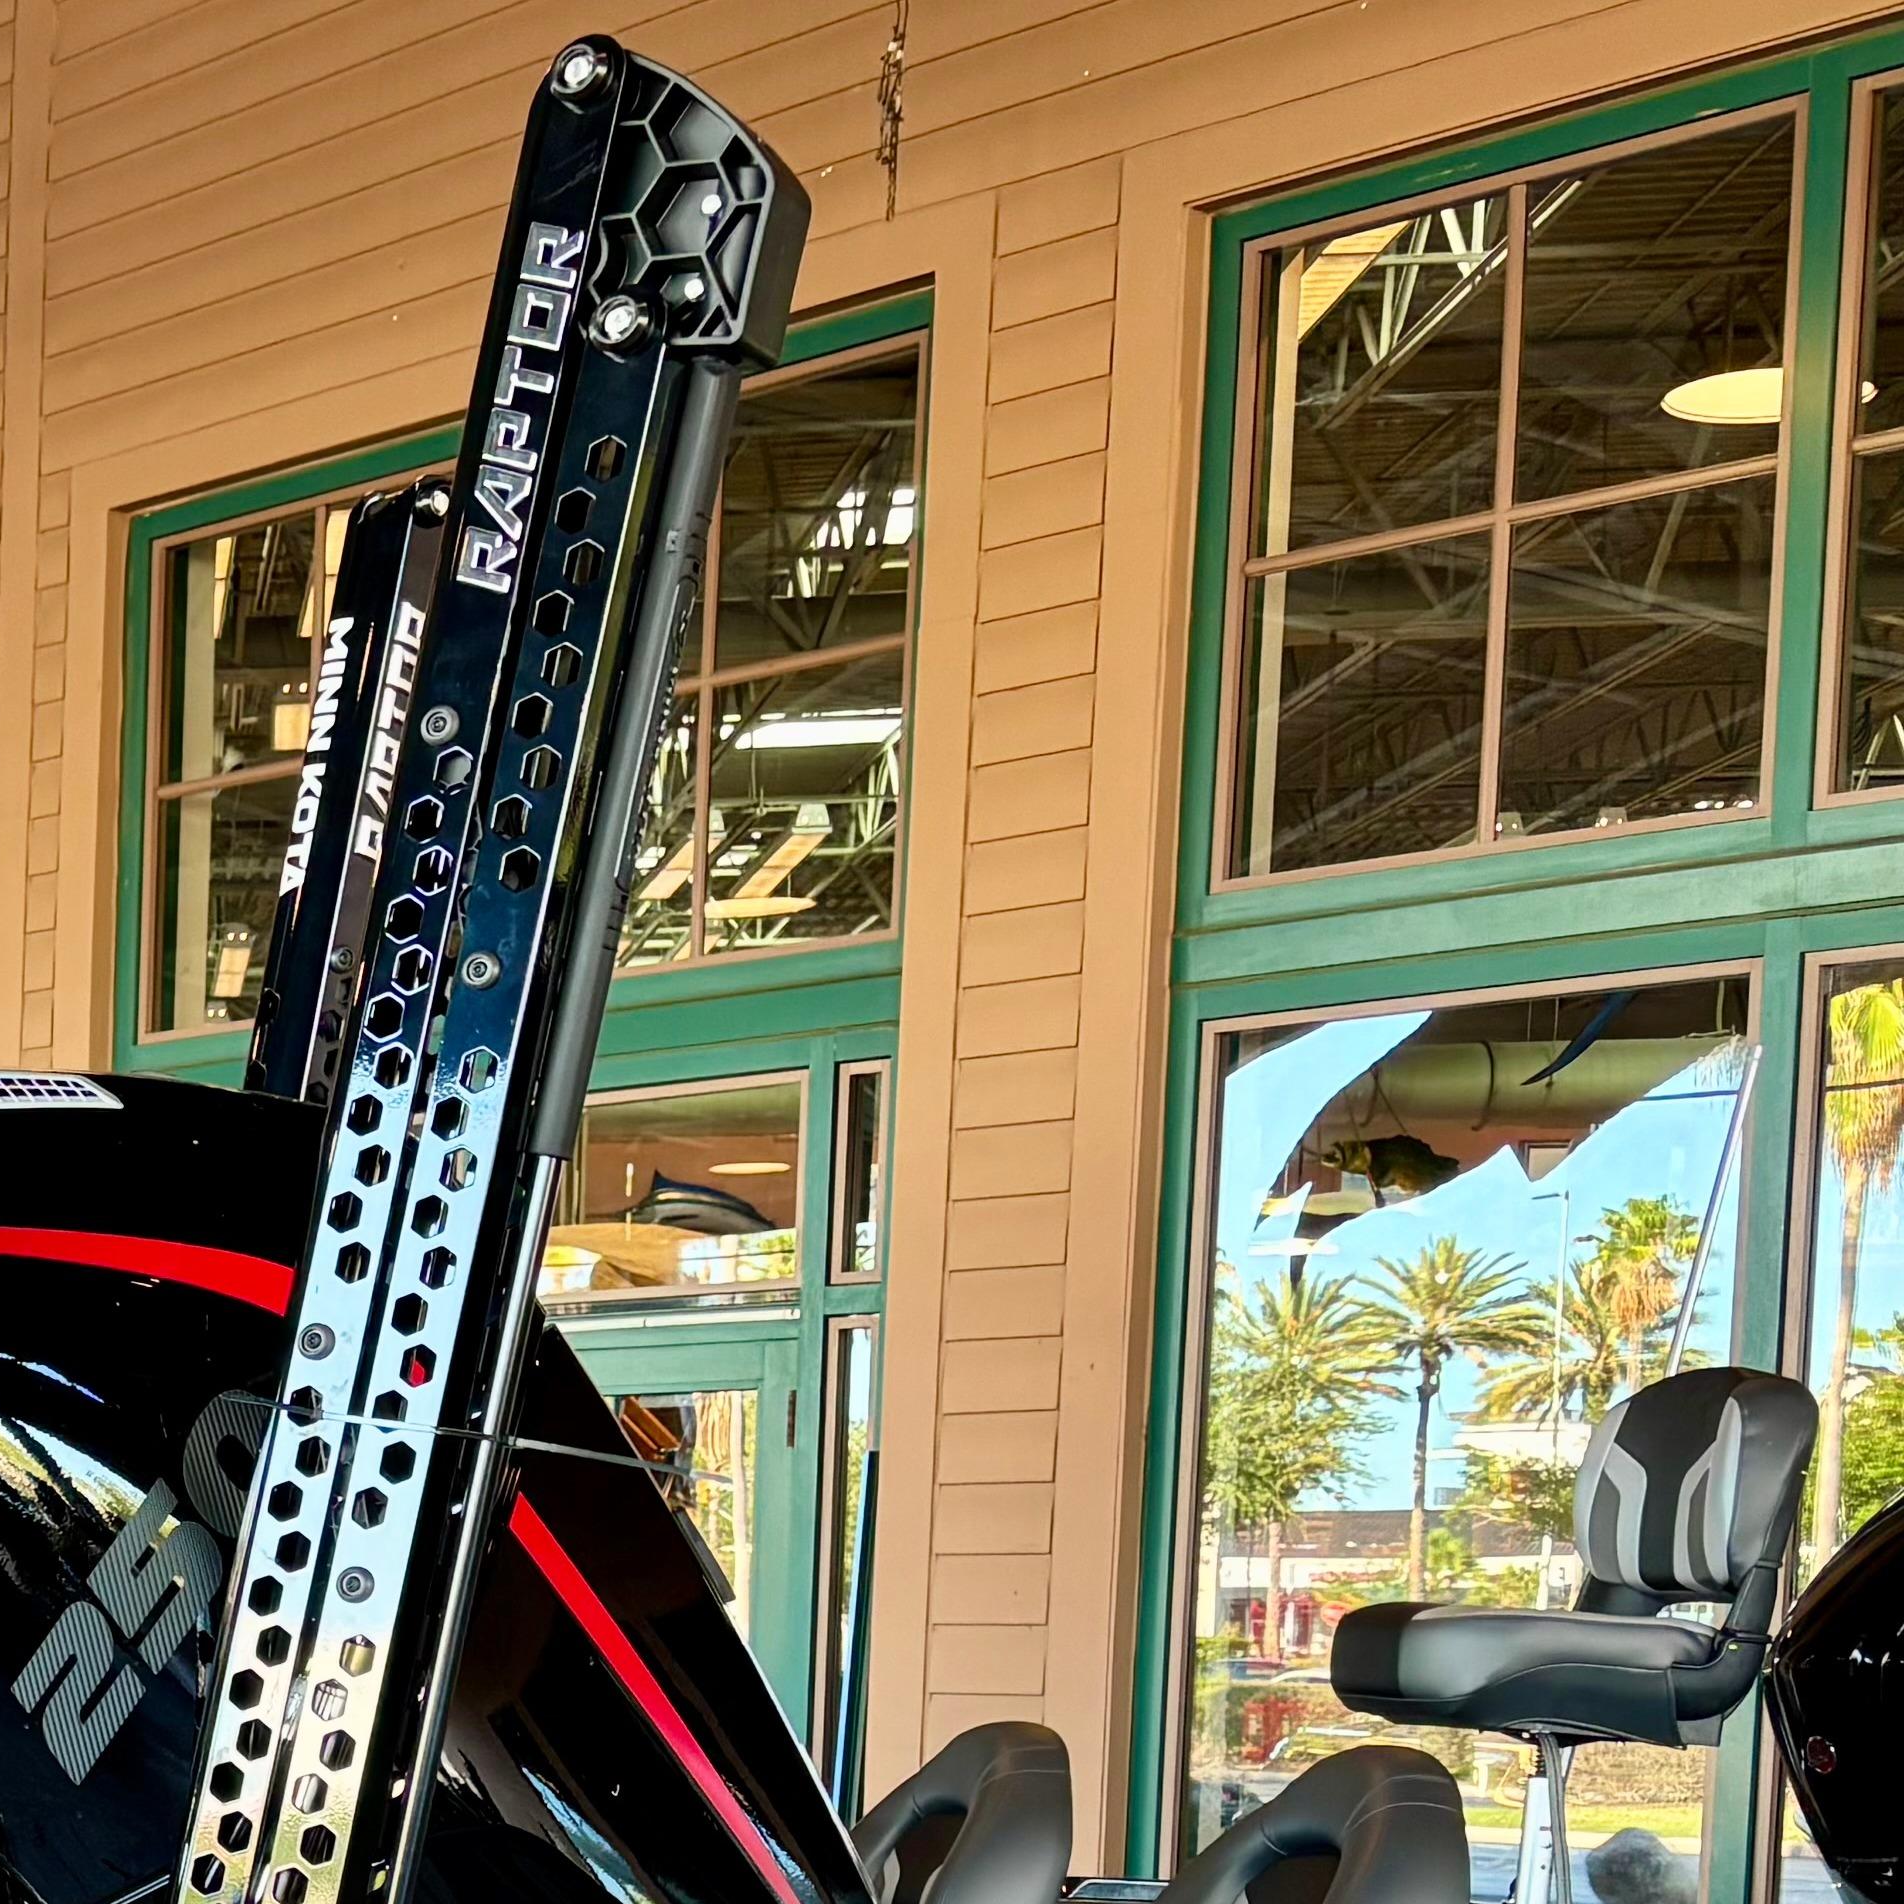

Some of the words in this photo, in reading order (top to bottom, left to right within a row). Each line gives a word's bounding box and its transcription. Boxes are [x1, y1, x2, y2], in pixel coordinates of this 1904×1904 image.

[456, 220, 585, 594] RAPTOR
[307, 616, 355, 753] MINN
[279, 763, 329, 897] KOTA
[11, 1389, 270, 1787] 250
